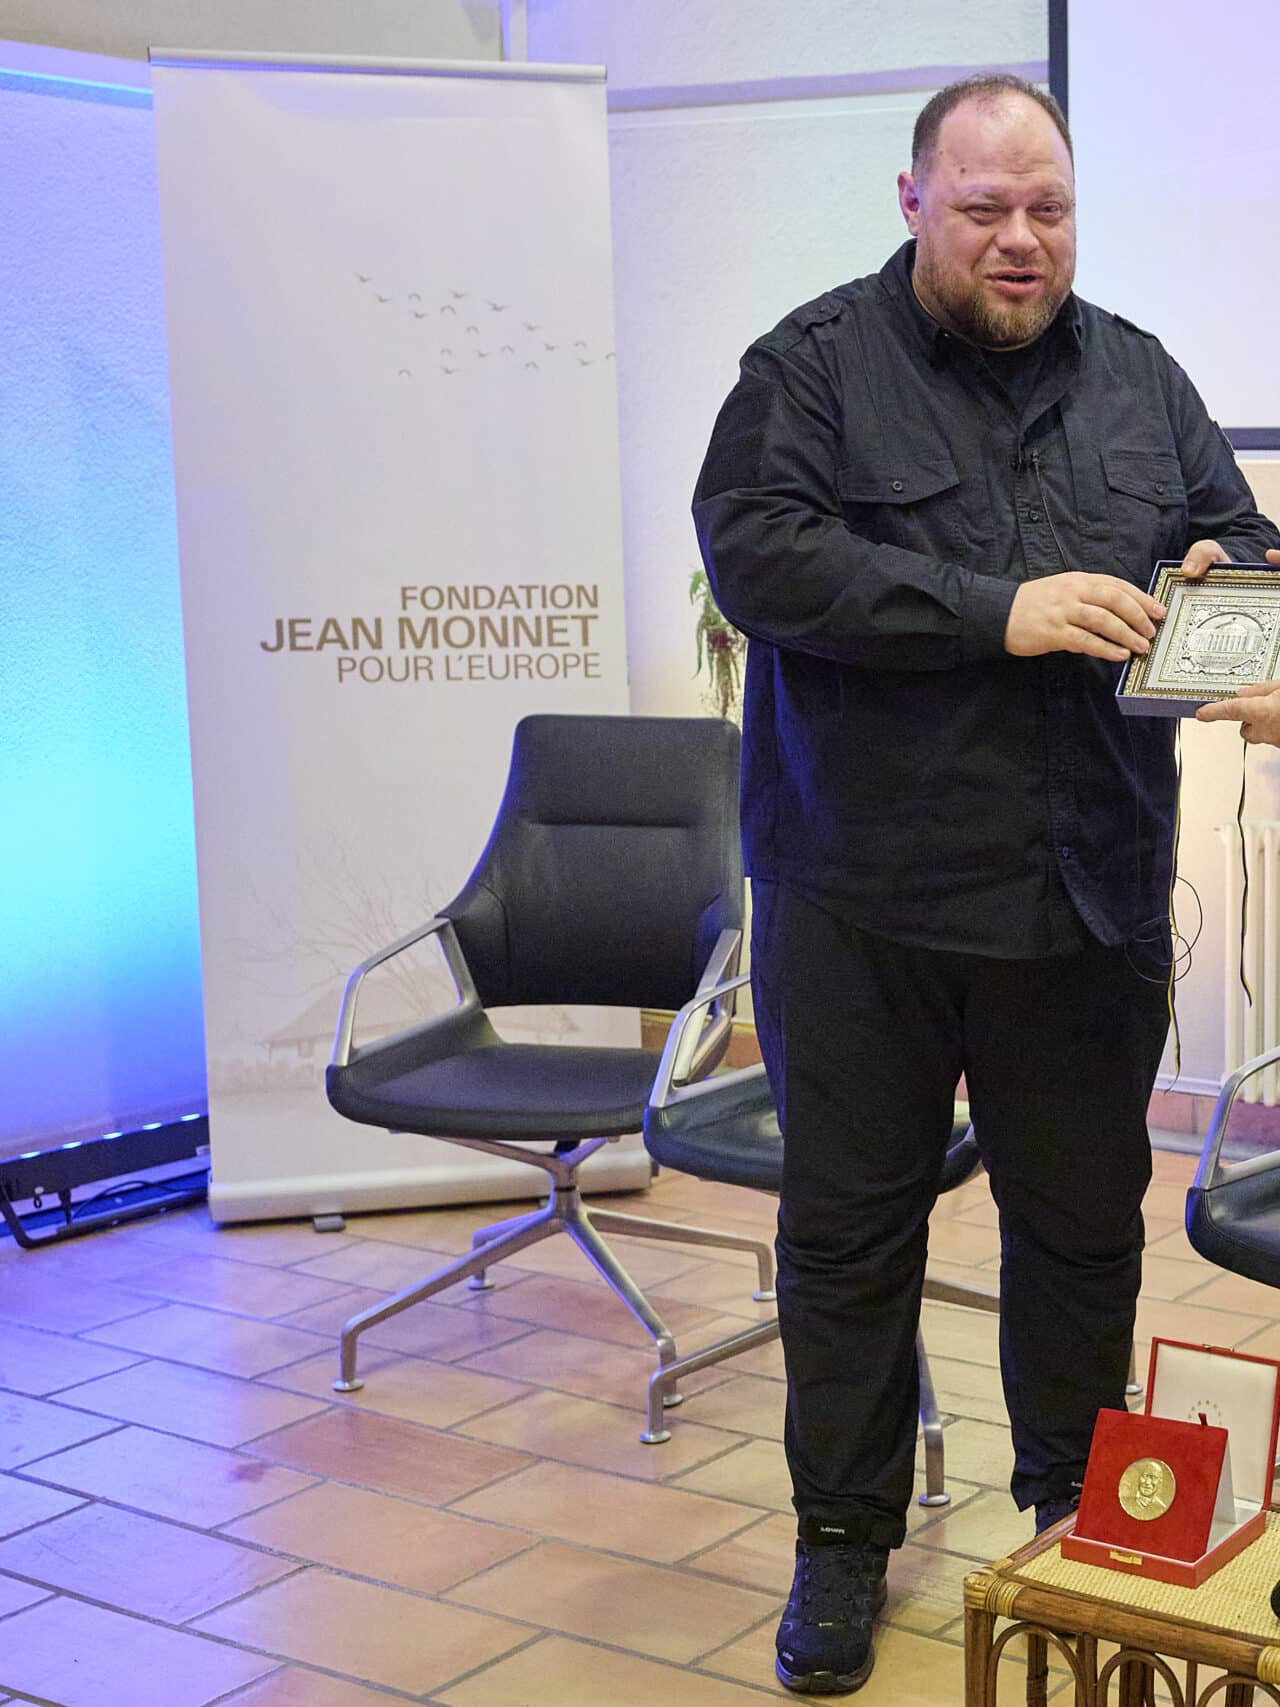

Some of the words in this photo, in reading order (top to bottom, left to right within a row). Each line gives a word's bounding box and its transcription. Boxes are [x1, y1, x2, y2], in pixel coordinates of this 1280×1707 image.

[401, 584, 599, 611] FONDATION
[260, 616, 383, 652] JEAN
[398, 614, 599, 649] MONNET
[337, 655, 433, 684] POUR
[445, 652, 601, 681] L'EUROPE
